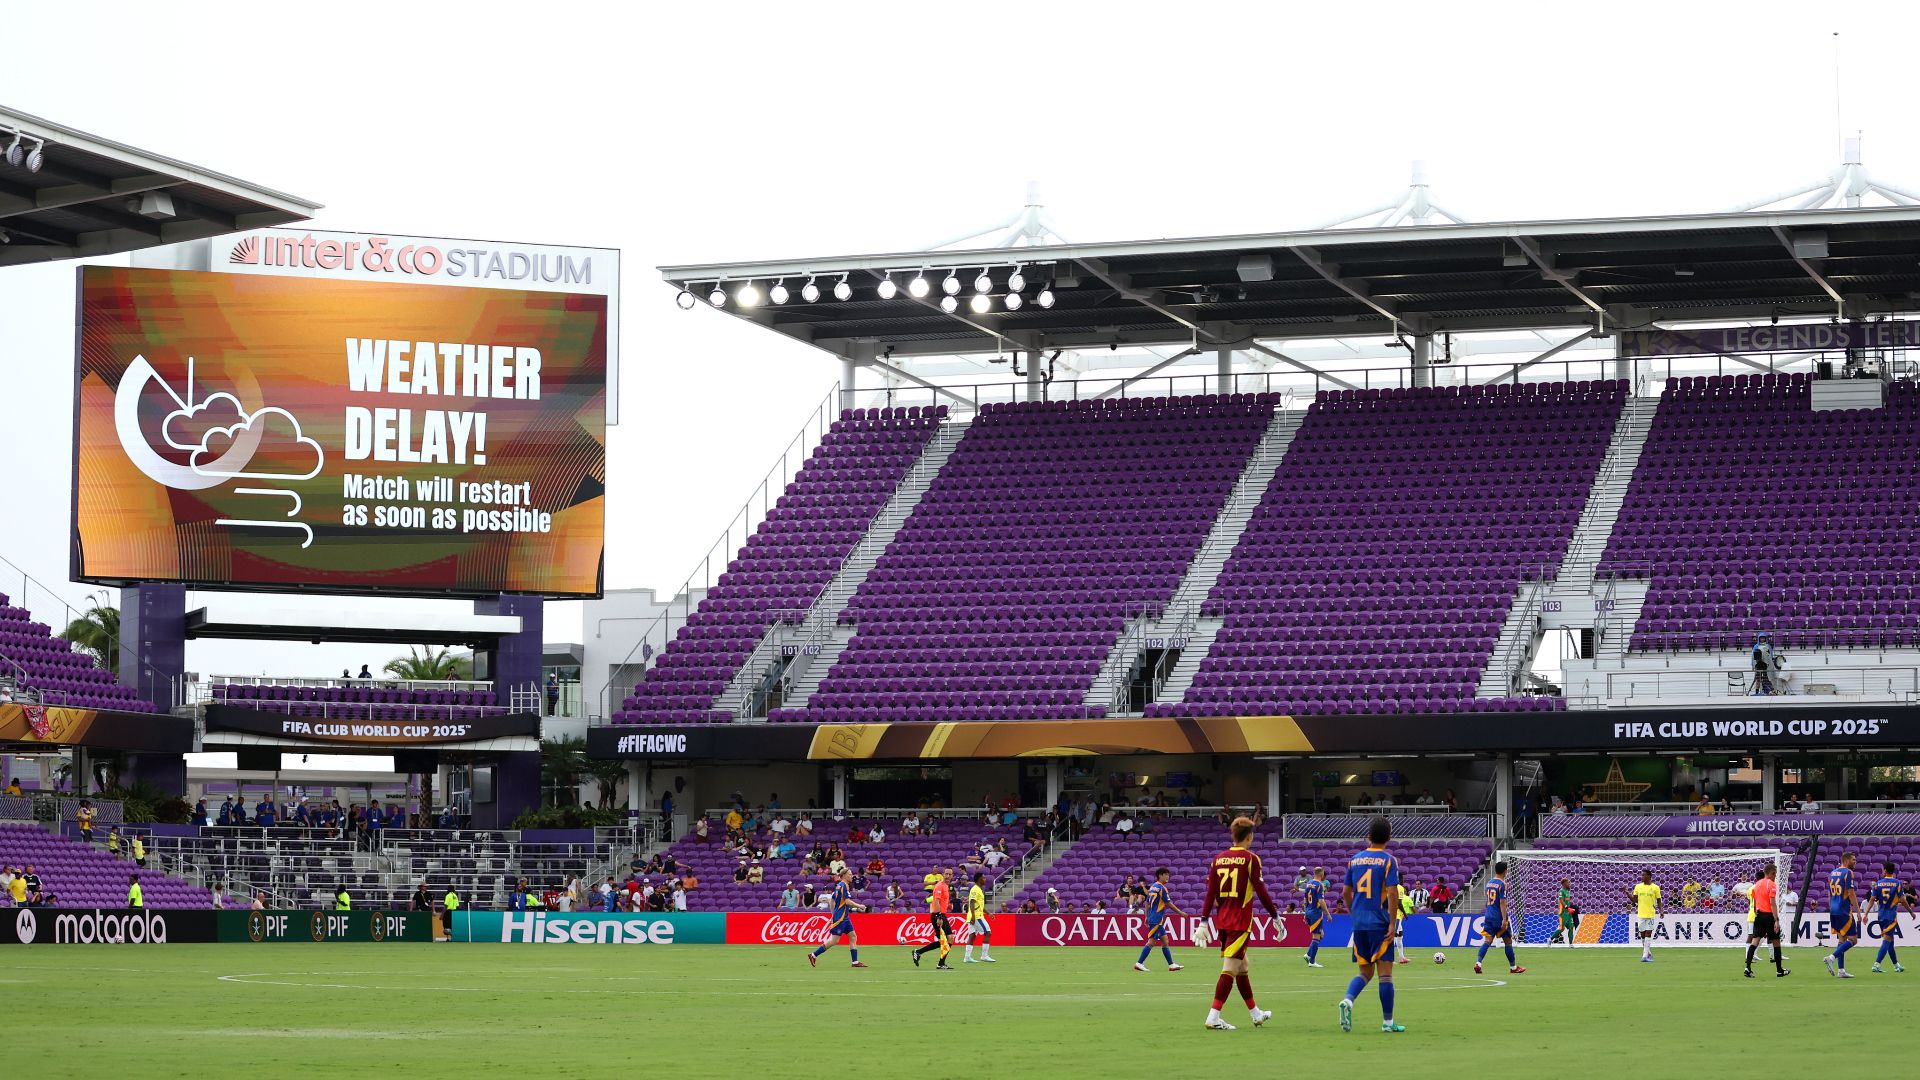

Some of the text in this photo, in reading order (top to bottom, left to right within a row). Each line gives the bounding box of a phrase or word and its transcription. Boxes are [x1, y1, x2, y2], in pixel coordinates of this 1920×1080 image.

[446, 248, 592, 285] STADIUM
[1722, 325, 1850, 351] LEGENDS
[345, 338, 542, 400] WEATHER
[344, 406, 487, 466] DELAY!
[343, 473, 531, 505] Match will restart
[343, 504, 551, 533] as soon as possible
[1543, 602, 1561, 611] 103
[782, 646, 799, 655] 101
[804, 646, 820, 655] 102
[1146, 639, 1163, 648] 102
[283, 721, 311, 735] FIFA
[314, 724, 349, 736] CLUB
[351, 725, 400, 737] WORLD
[403, 725, 430, 737] CUP
[1614, 722, 1655, 738] FIFA
[1659, 721, 1708, 738] CLUB
[1712, 720, 1784, 737] WORLD
[1788, 719, 1827, 735] CUP
[617, 734, 686, 754] #FIFACWC
[1698, 819, 1824, 833] inter&co STADIUM
[1216, 867, 1239, 898] 21
[1356, 868, 1373, 899] 4
[1829, 878, 1842, 896] 66
[1486, 888, 1497, 905] 19
[1881, 888, 1891, 904] 5
[55, 908, 167, 944] motorola
[266, 915, 289, 937] PIF
[327, 915, 349, 937] PIF
[386, 916, 407, 937] PIF
[501, 912, 675, 944] Hisense
[1041, 917, 1143, 946] QATAR
[1427, 916, 1490, 947] VIS
